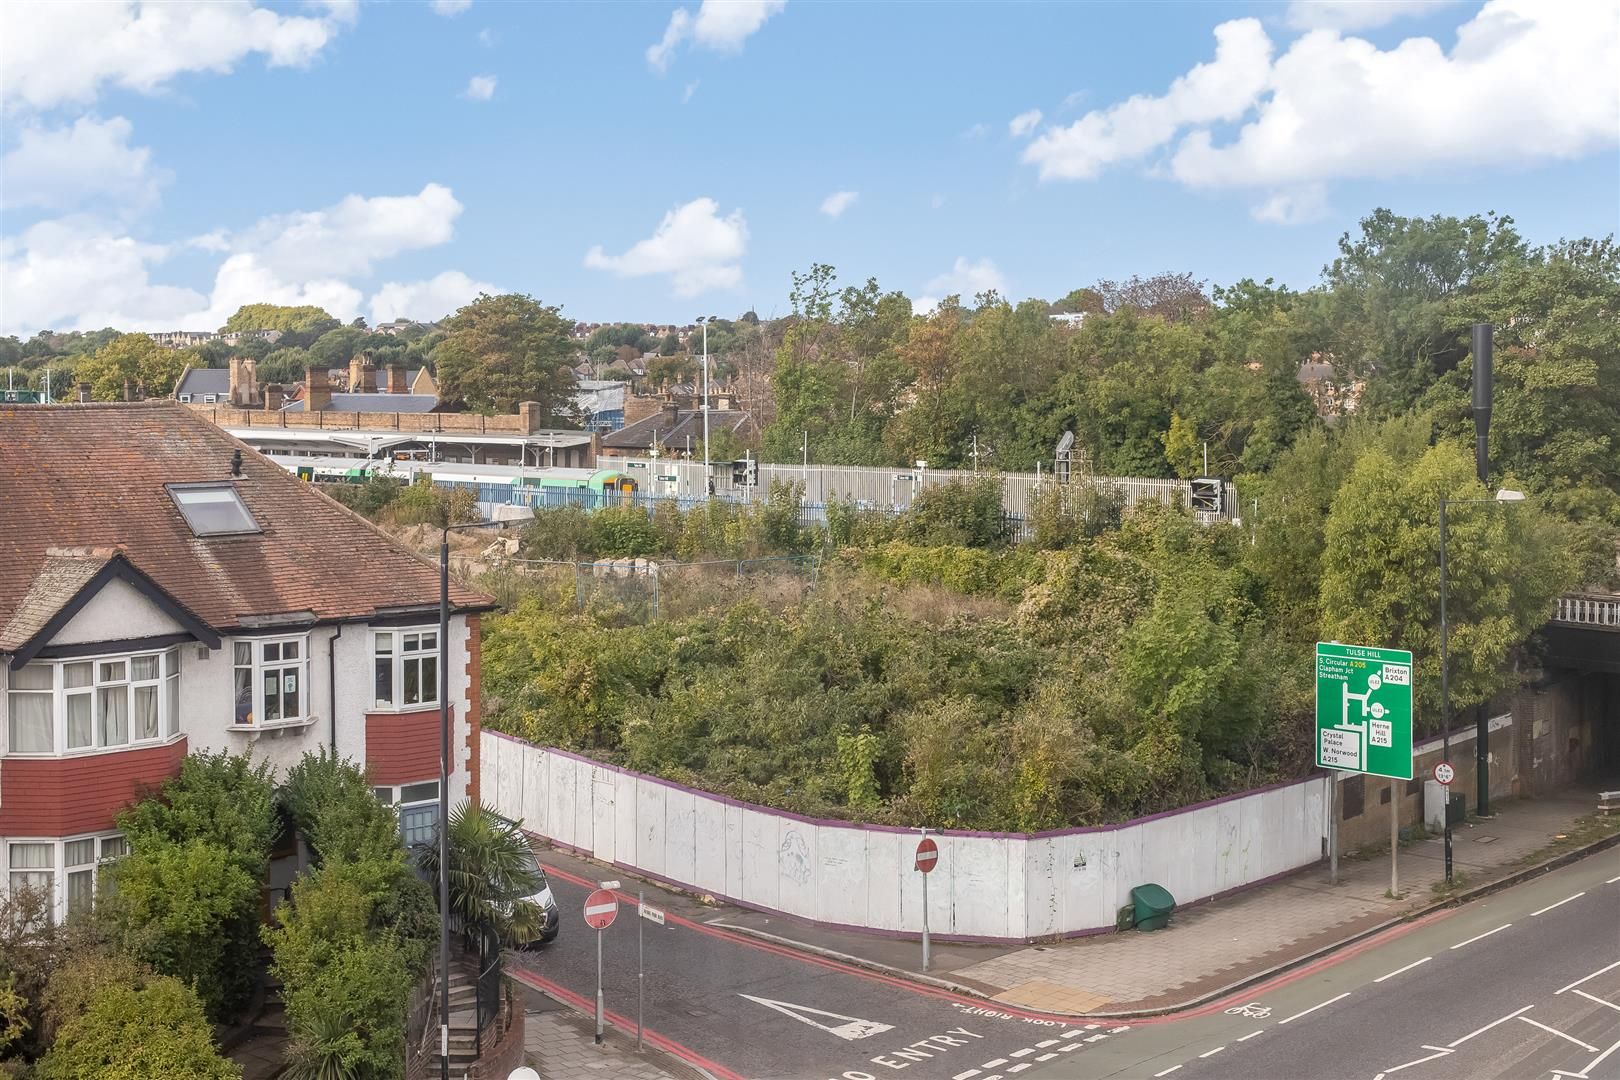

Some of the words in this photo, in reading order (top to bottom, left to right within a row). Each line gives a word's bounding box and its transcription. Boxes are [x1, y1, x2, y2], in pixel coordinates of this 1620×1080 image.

[1345, 648, 1366, 657] TULSE
[1367, 650, 1381, 658] HILL
[1319, 657, 1325, 665] S.
[1325, 658, 1348, 667] Circular
[1319, 665, 1344, 674] Clapham
[1384, 667, 1408, 675] Brixton
[1319, 671, 1349, 681] Streatham
[1384, 674, 1403, 682] A204
[1371, 721, 1390, 729] Herne
[1322, 730, 1344, 740] Crystal
[1375, 729, 1386, 737] Hill
[1323, 738, 1343, 746] Palace
[1371, 736, 1388, 744] A215
[1331, 748, 1358, 757] Norwood
[1322, 755, 1338, 763] A215
[960, 1006, 1013, 1020] RIGHT
[1023, 1017, 1067, 1028] LOOK
[870, 1026, 984, 1070] ENTRY
